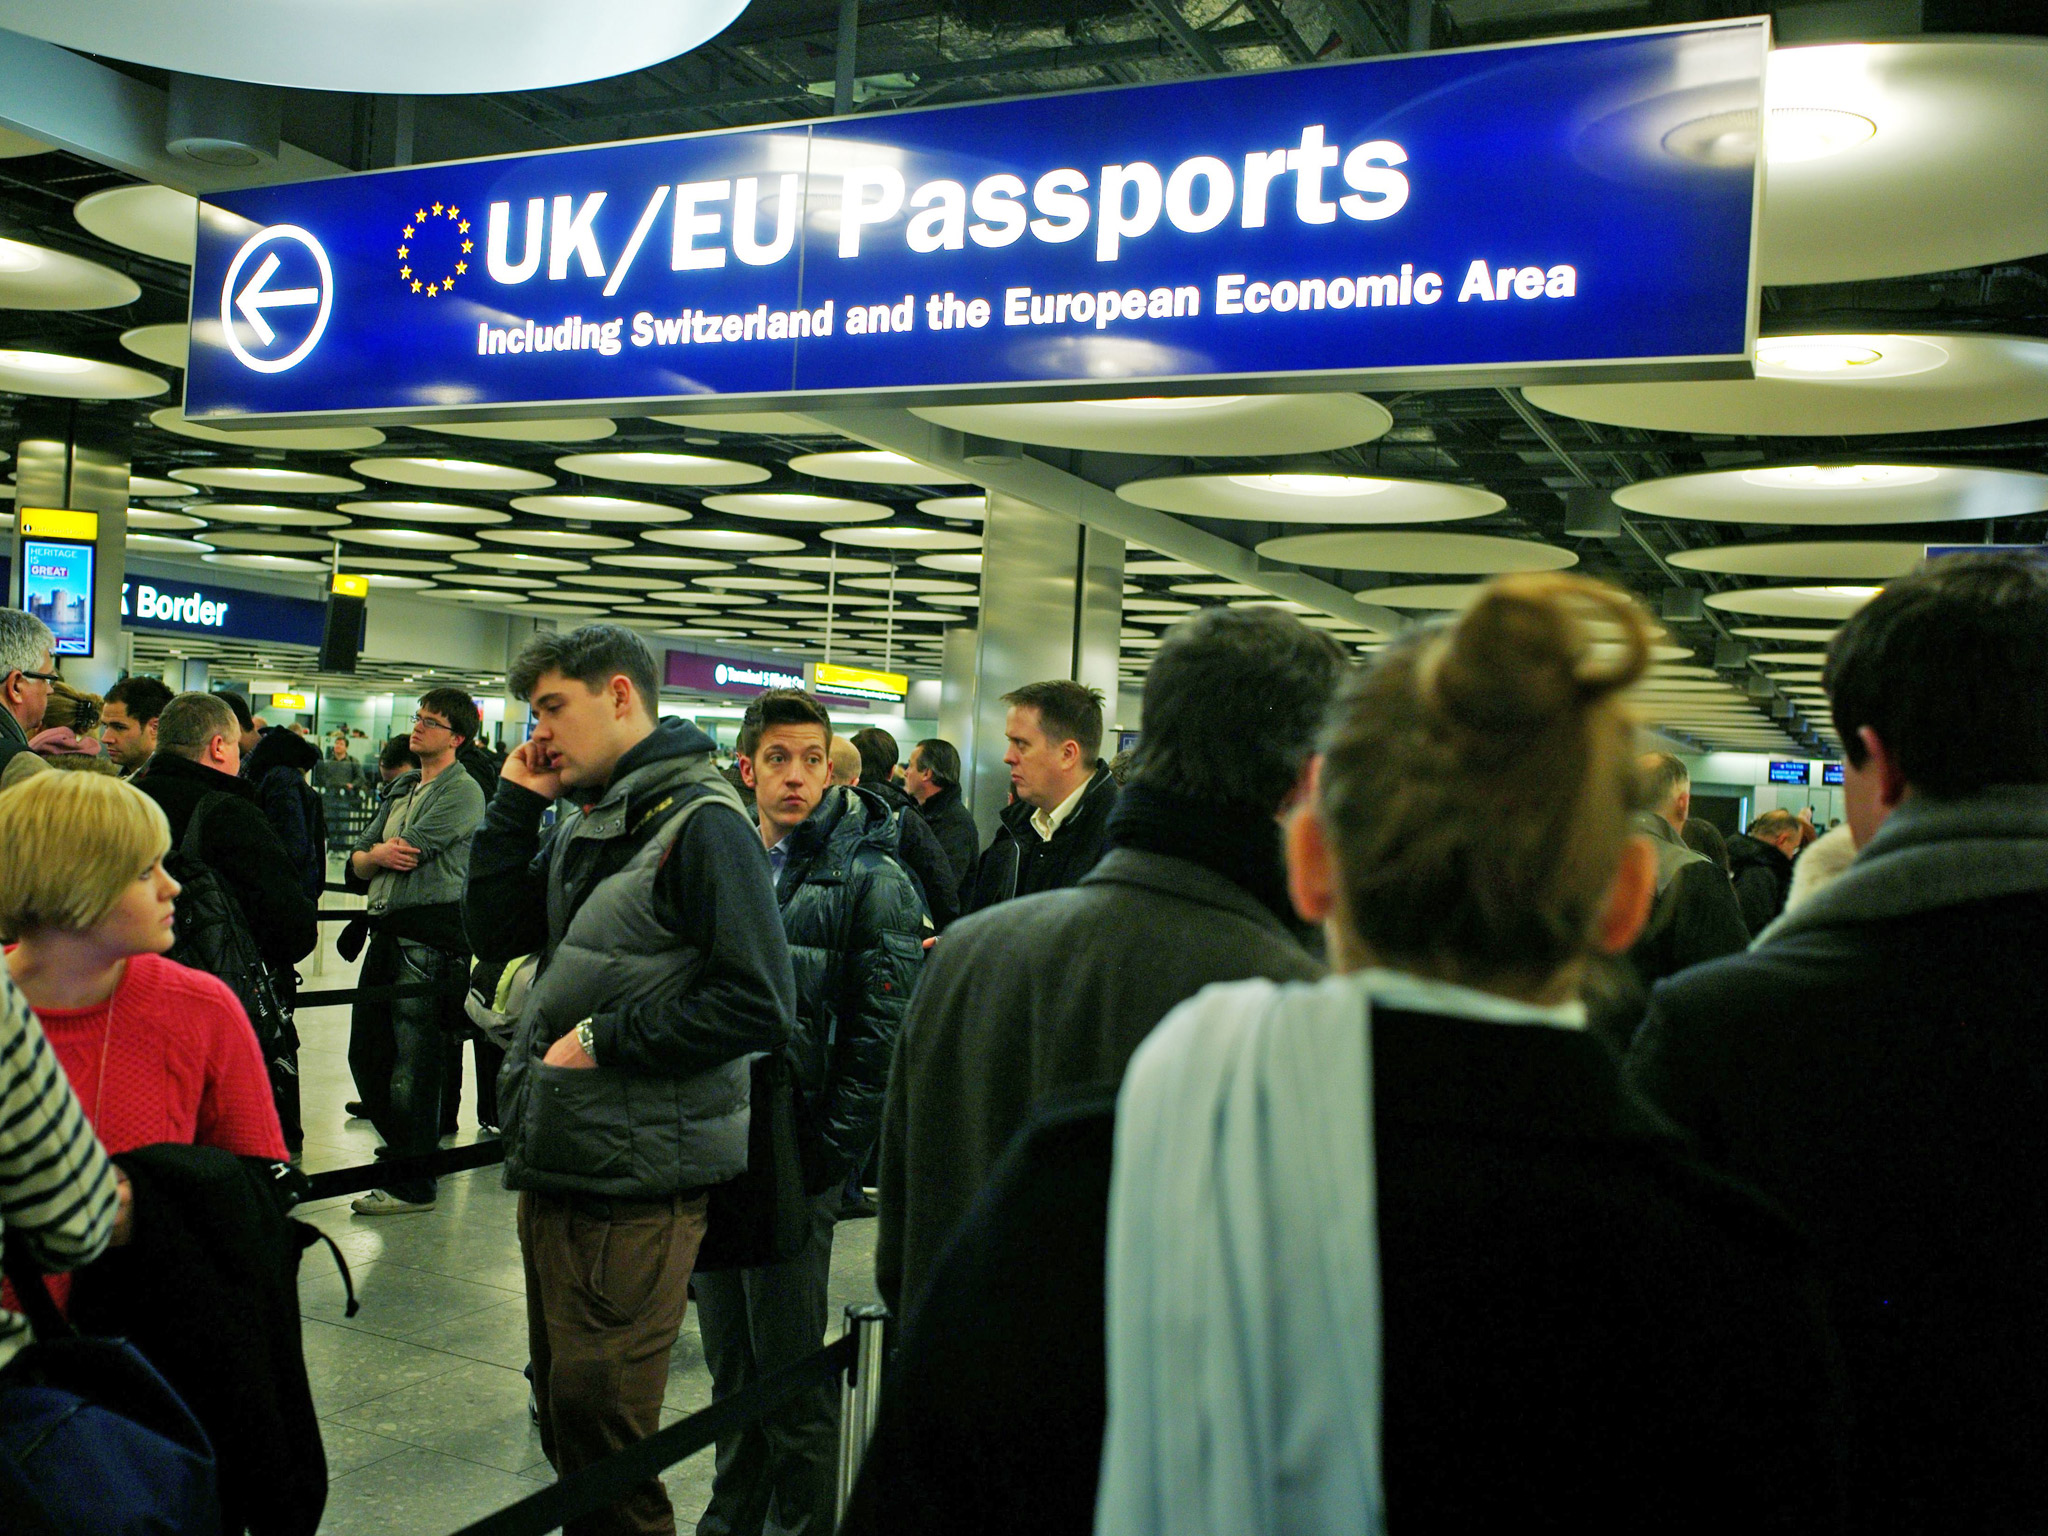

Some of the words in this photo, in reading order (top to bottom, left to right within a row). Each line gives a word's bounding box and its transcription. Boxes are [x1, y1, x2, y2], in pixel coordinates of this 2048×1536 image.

[486, 173, 799, 297] UK/EU
[838, 124, 1410, 262] Passports
[477, 316, 623, 356] Including
[631, 300, 834, 347] Switzerland
[845, 295, 915, 335] and
[926, 292, 991, 331] the
[1003, 283, 1200, 329] European
[1215, 263, 1443, 315] Economic
[1457, 260, 1577, 303] Area
[30, 547, 78, 559] HERITAGE
[30, 556, 40, 565] IS
[31, 565, 67, 577] GREAT
[136, 584, 229, 627] Border
[727, 666, 763, 686] Terminal
